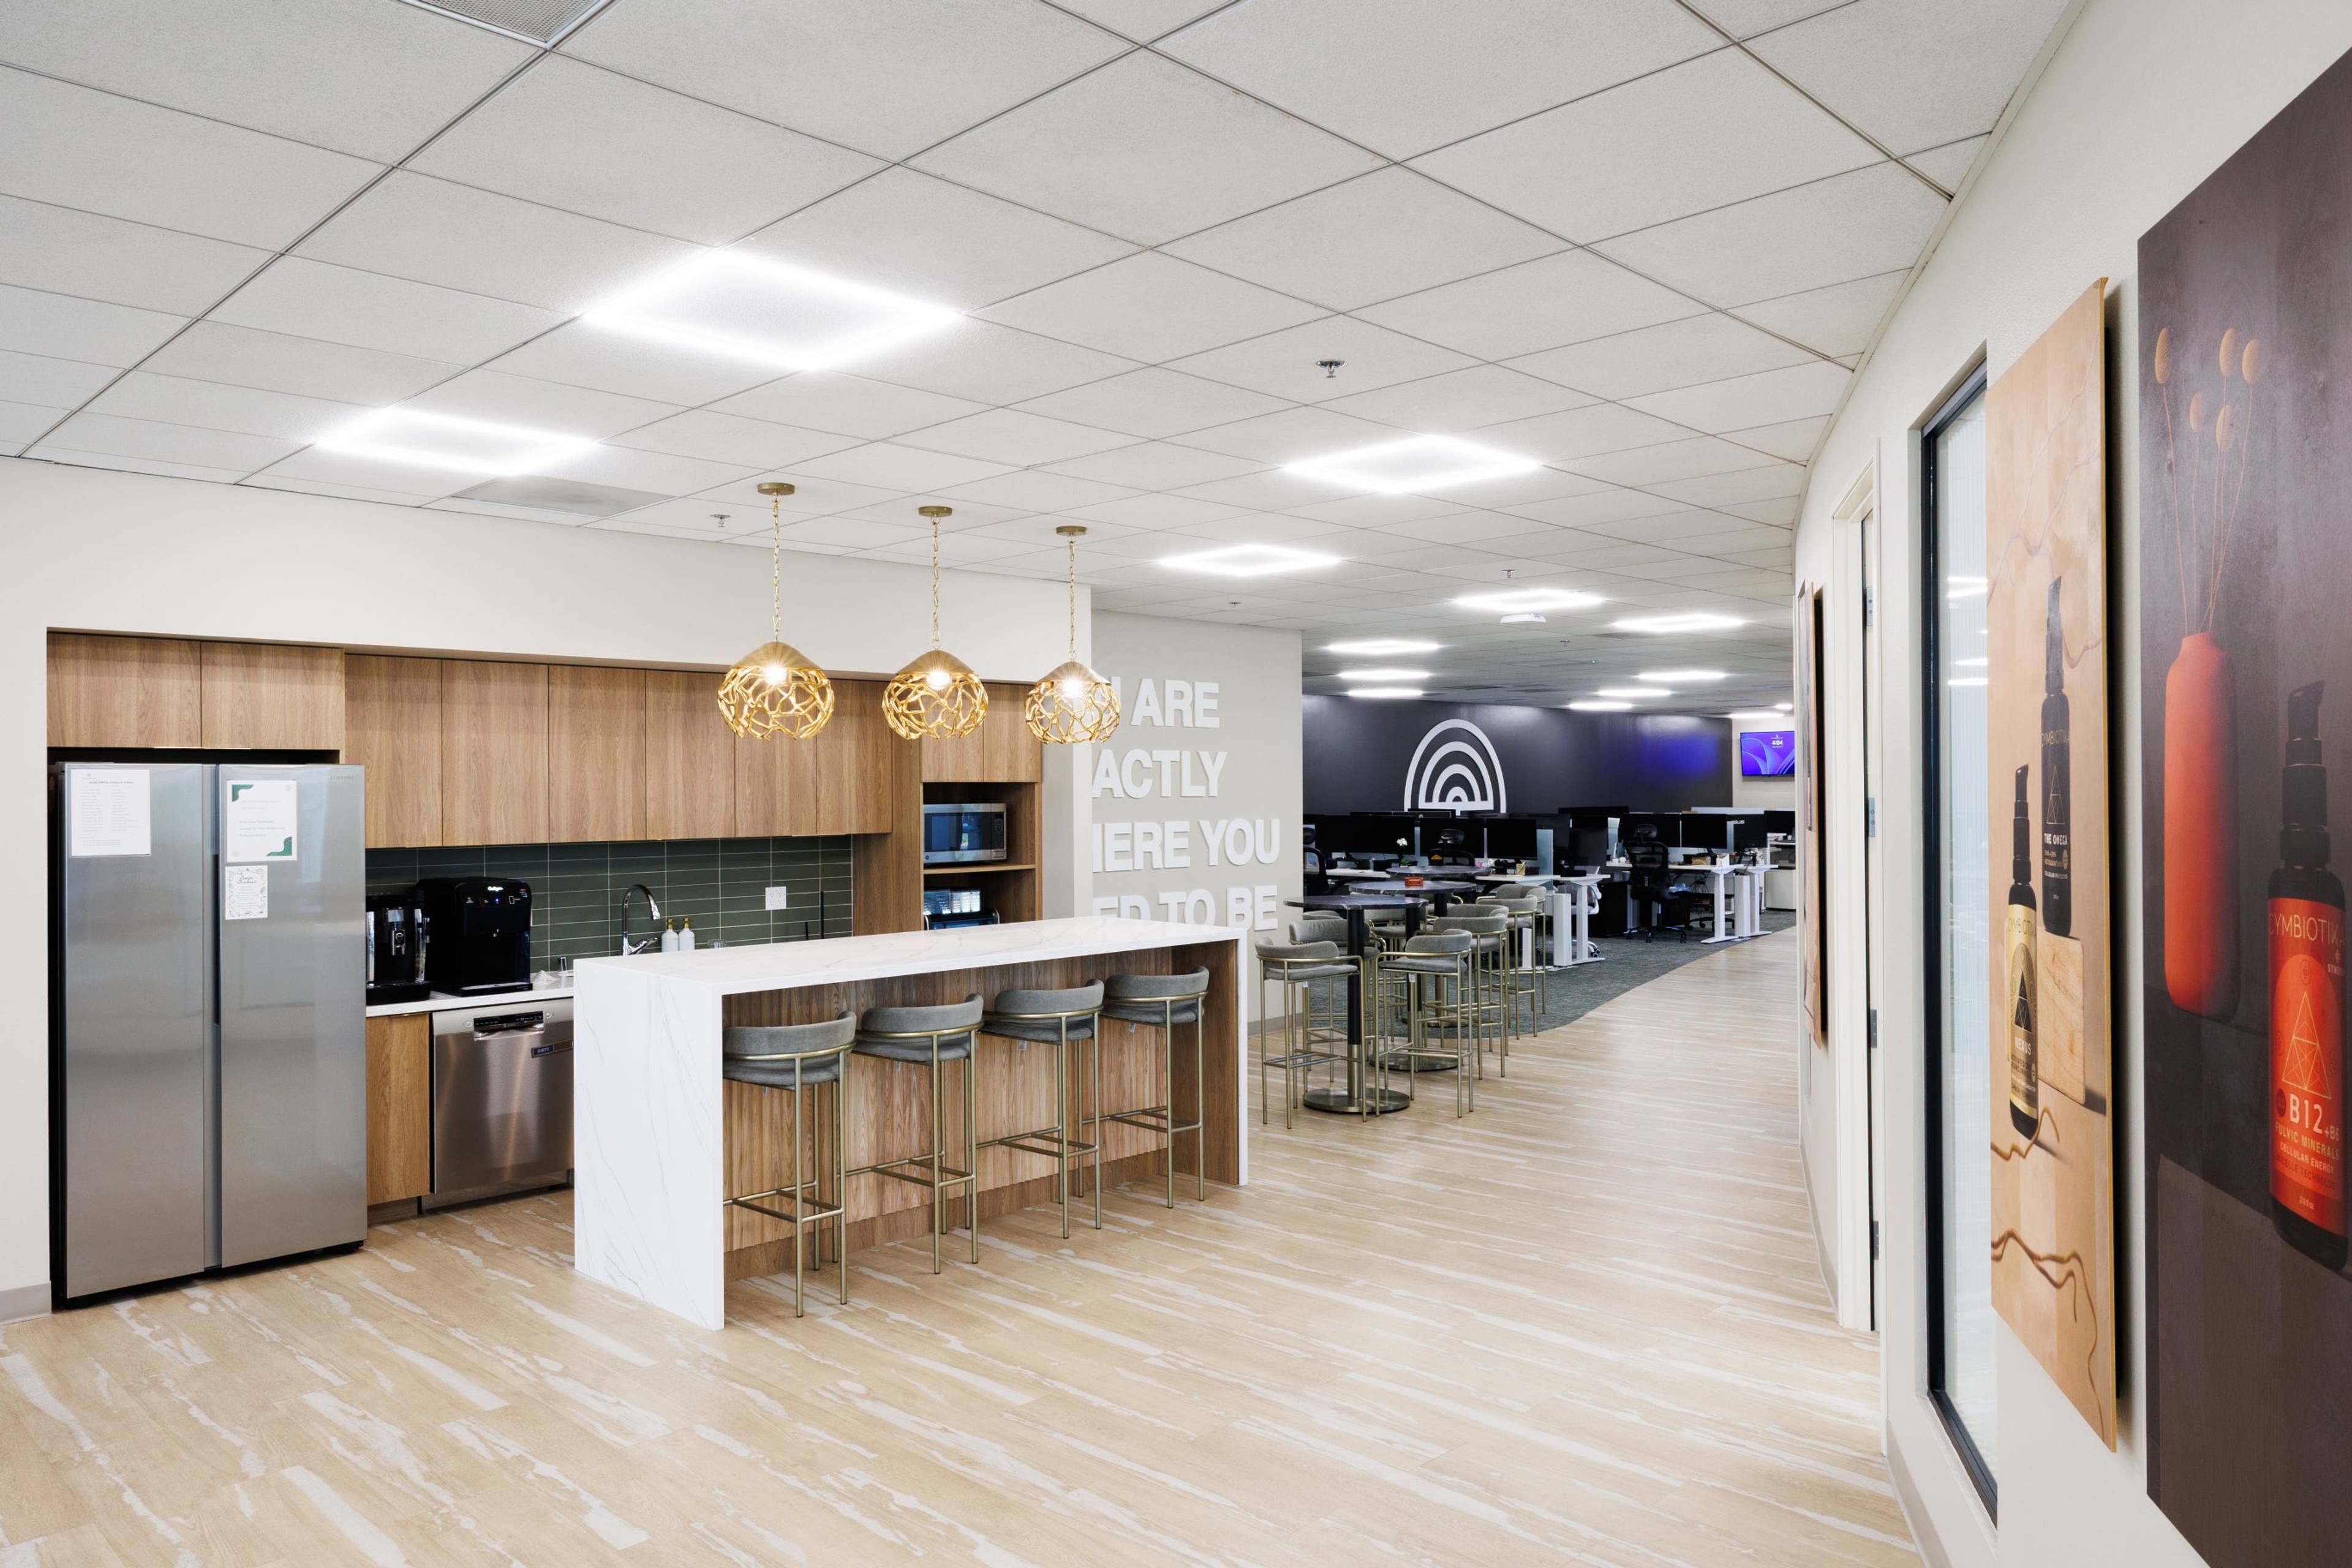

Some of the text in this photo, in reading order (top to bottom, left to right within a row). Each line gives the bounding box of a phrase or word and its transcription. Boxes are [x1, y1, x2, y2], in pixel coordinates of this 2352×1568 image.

[1131, 678, 1219, 728] ARE
[1198, 818, 1280, 865] YOU
[1159, 889, 1216, 927] TO
[1227, 885, 1278, 931] BE
[2015, 1036, 2032, 1056] NEXUS
[2275, 1121, 2340, 1161] FULVIC MINERALS
[2280, 1141, 2334, 1174] CELLULAR ENERGY
